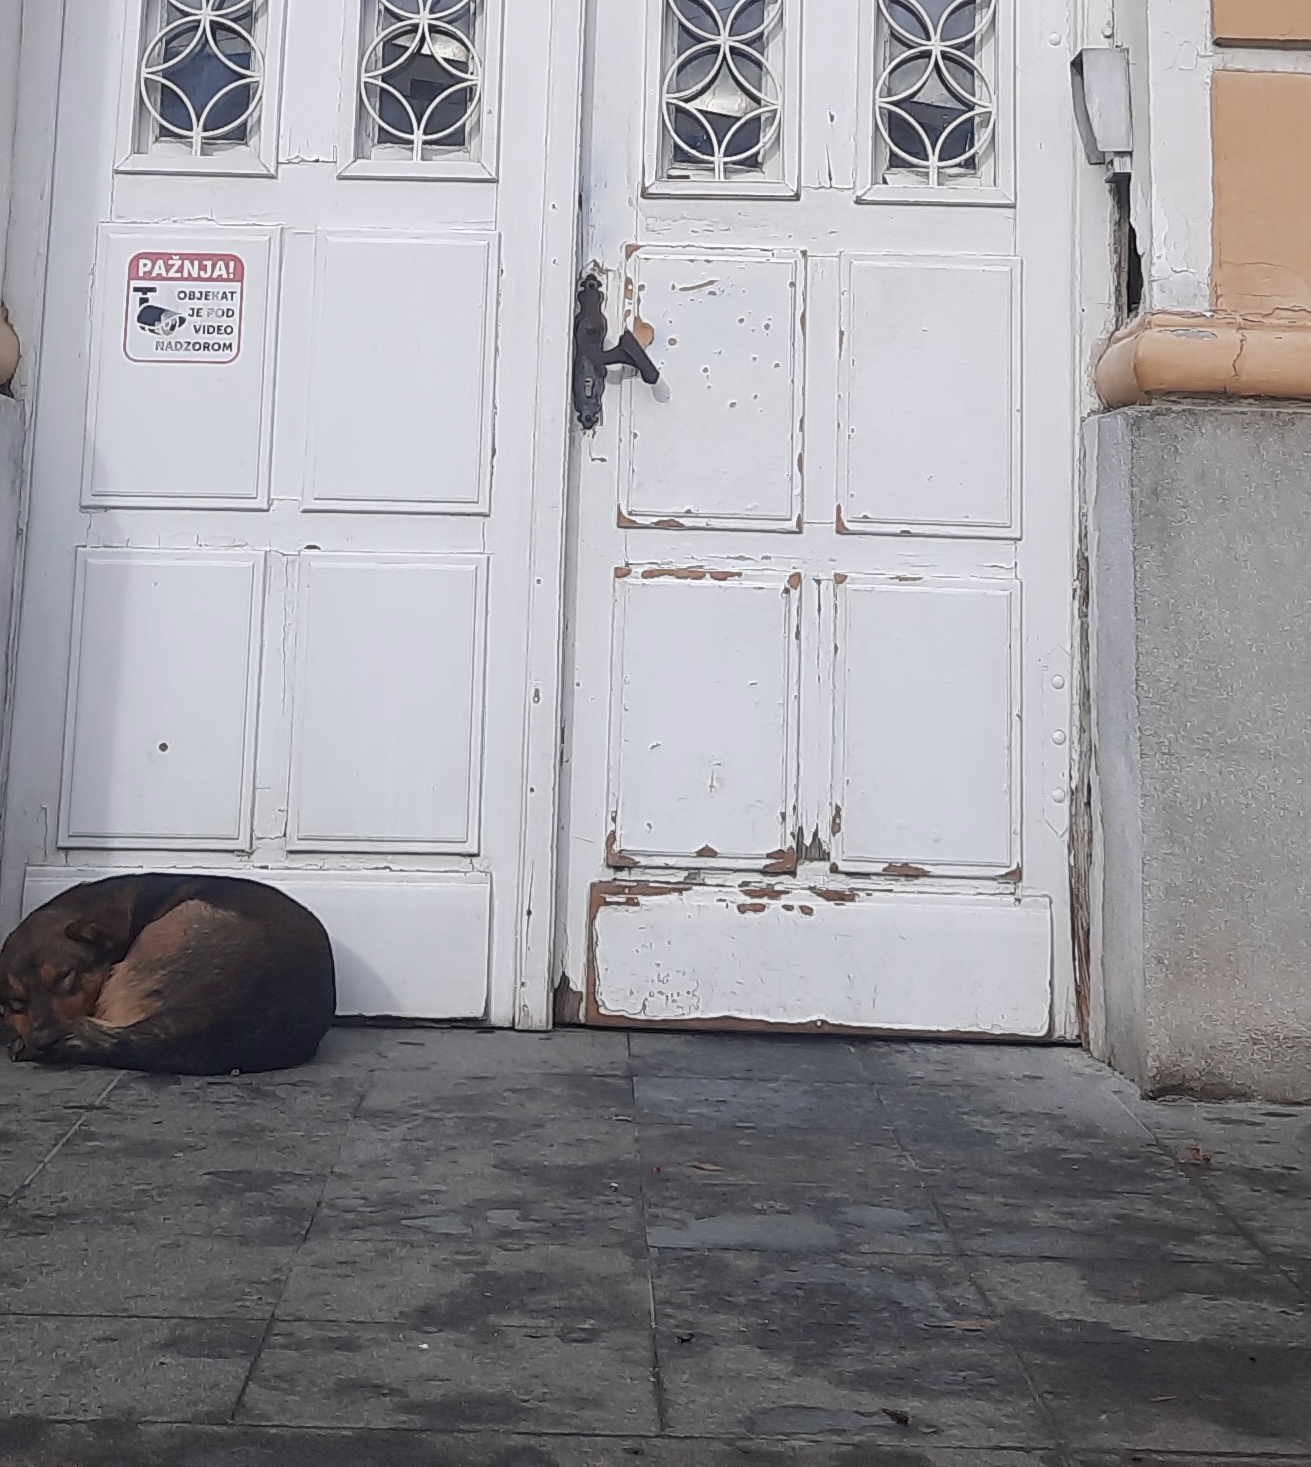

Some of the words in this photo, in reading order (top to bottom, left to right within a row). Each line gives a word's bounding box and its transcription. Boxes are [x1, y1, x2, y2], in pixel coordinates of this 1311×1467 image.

[138, 255, 235, 279] PAŽNJA!
[177, 290, 237, 301] OBJEKAT
[188, 307, 203, 318] JE
[206, 308, 235, 318] POD
[193, 324, 234, 335] VIDEO
[154, 340, 233, 352] NADZOROM
